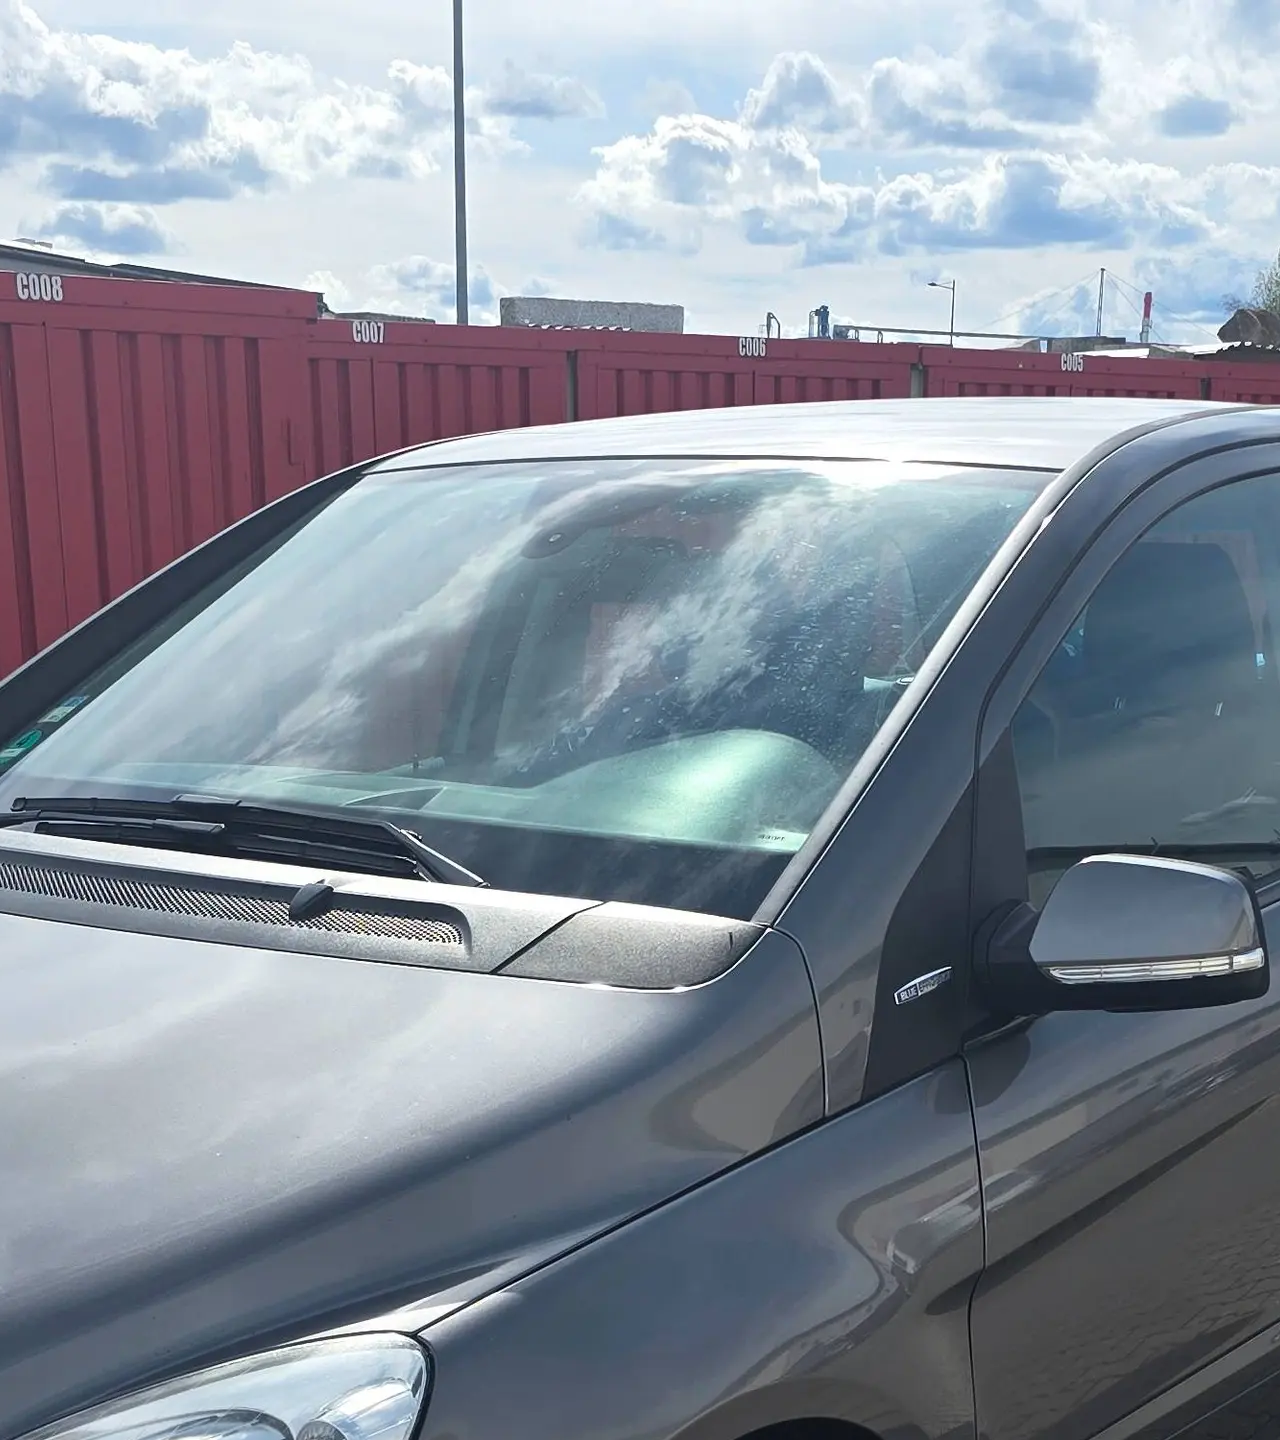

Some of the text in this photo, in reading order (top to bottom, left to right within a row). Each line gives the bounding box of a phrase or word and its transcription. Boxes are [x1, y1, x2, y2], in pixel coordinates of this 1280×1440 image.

[16, 272, 63, 302] C008
[352, 320, 385, 344] C007
[739, 337, 766, 357] C006
[1061, 353, 1084, 372] C005
[900, 986, 918, 1001] BLUE
